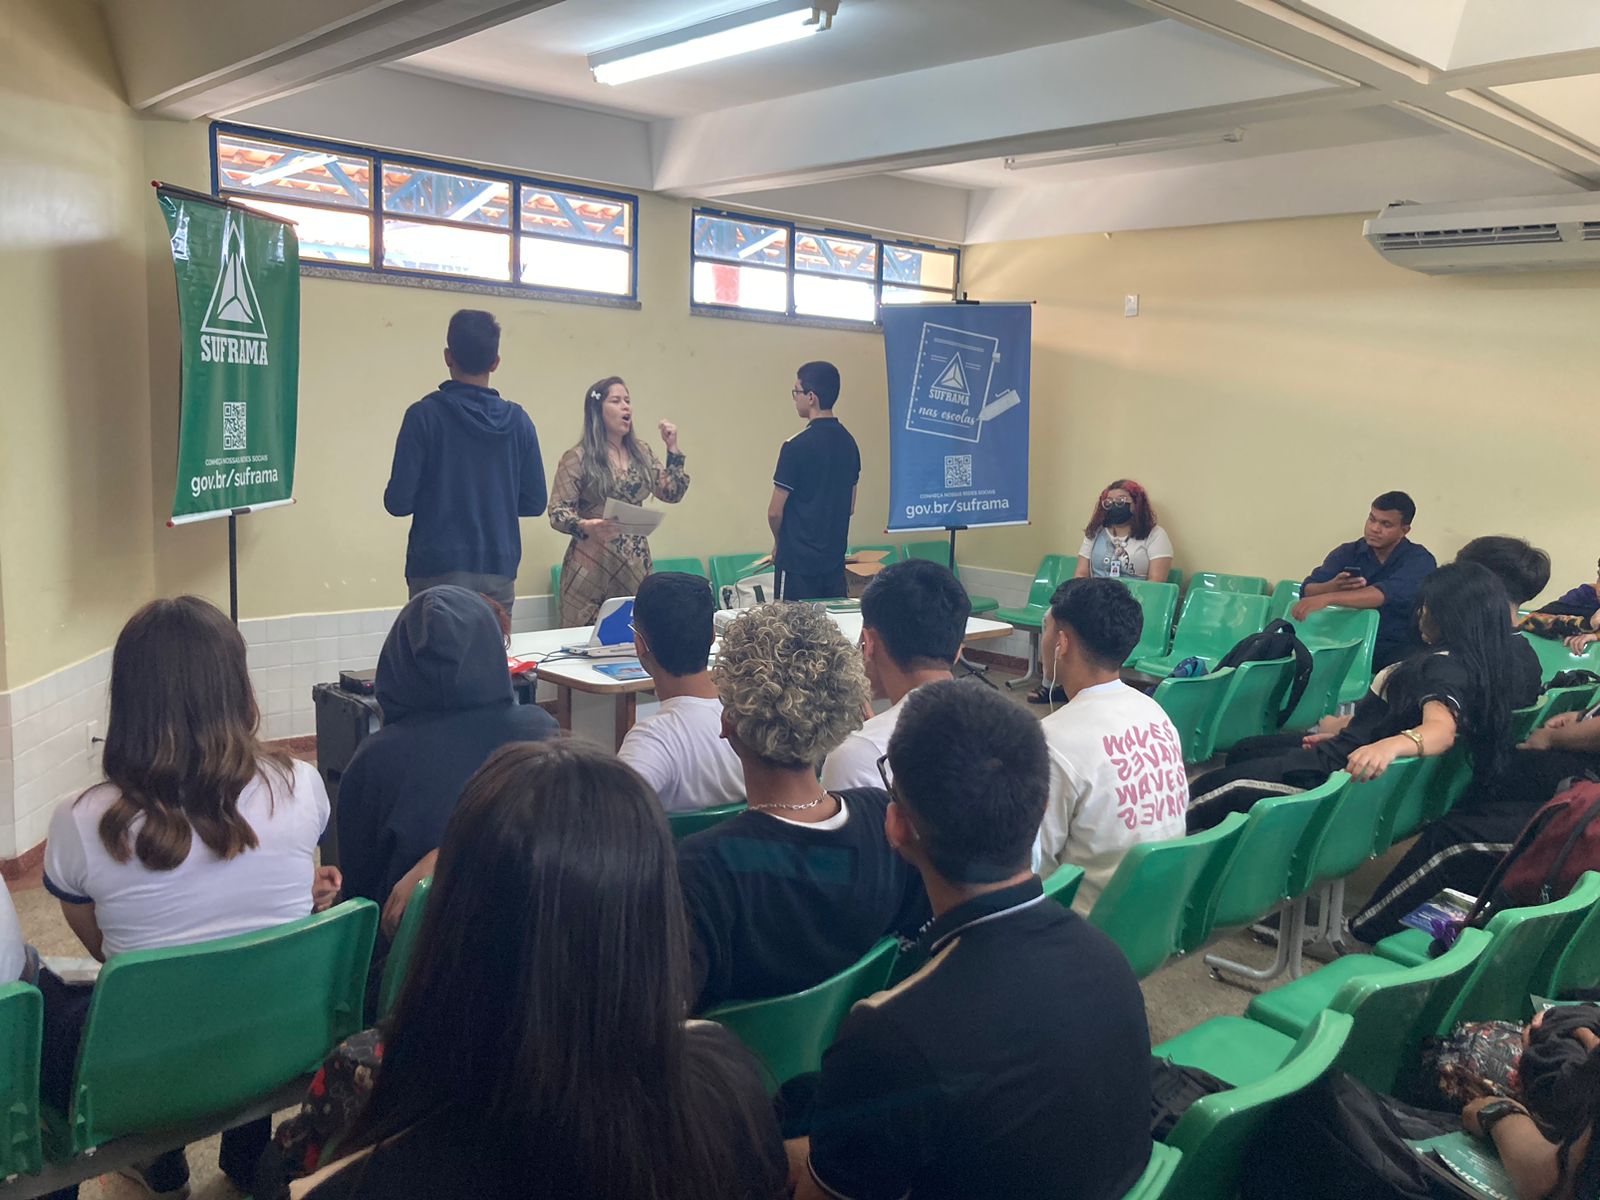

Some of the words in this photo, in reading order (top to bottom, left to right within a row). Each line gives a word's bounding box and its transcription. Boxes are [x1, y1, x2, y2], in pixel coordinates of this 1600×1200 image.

[200, 334, 268, 366] SUFRAMA
[928, 388, 970, 406] SUFRAMA
[918, 406, 938, 418] nas
[941, 408, 976, 425] escolas
[191, 466, 279, 497] gov.br/suframa
[905, 497, 1009, 519] gov.br/suframa
[1102, 719, 1174, 757] WAVES
[1115, 765, 1185, 806] WAVES
